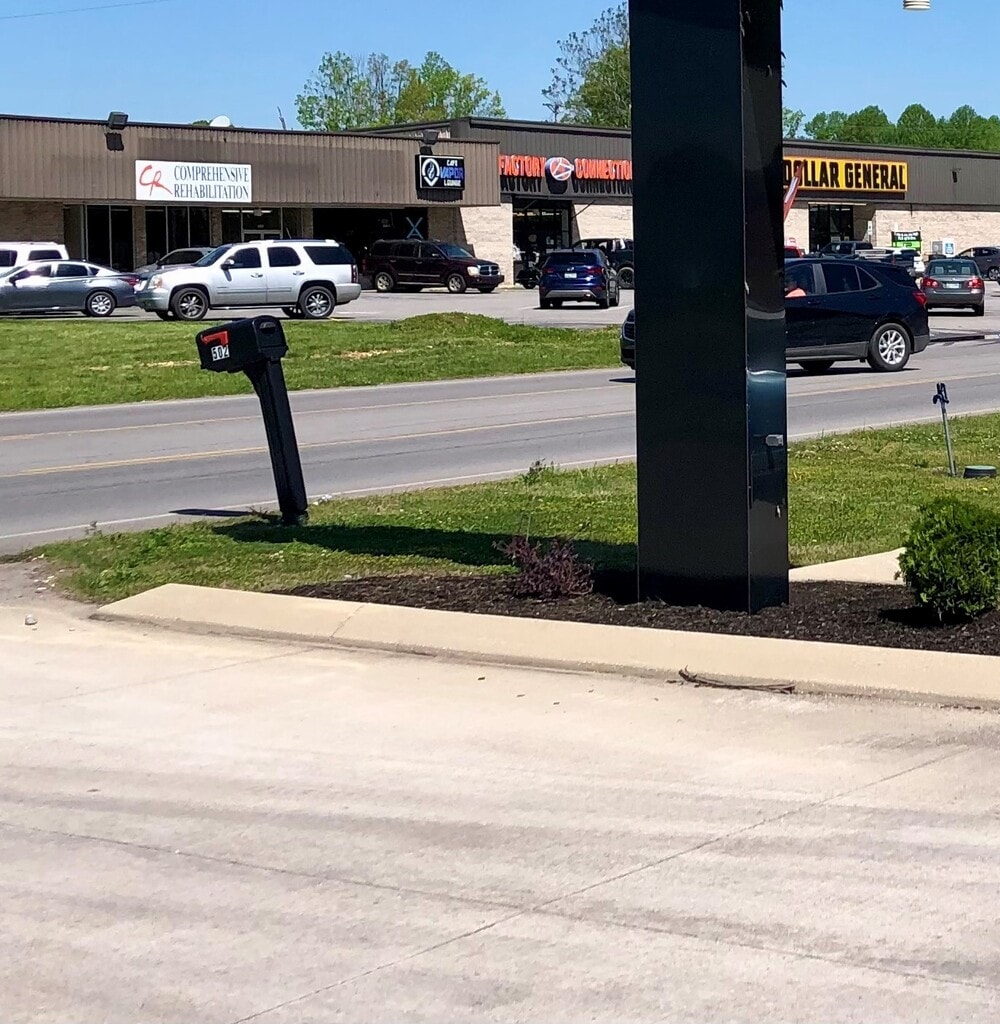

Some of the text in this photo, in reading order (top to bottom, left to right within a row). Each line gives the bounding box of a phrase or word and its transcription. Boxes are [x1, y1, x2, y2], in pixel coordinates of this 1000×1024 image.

[173, 165, 249, 182] COMPREHENSIVE
[440, 166, 464, 179] VAPOR
[498, 154, 632, 180] FACTORY CONNECTIO
[844, 163, 906, 189] GENERAL
[174, 183, 249, 199] REHABILITATION
[212, 346, 229, 360] 502
